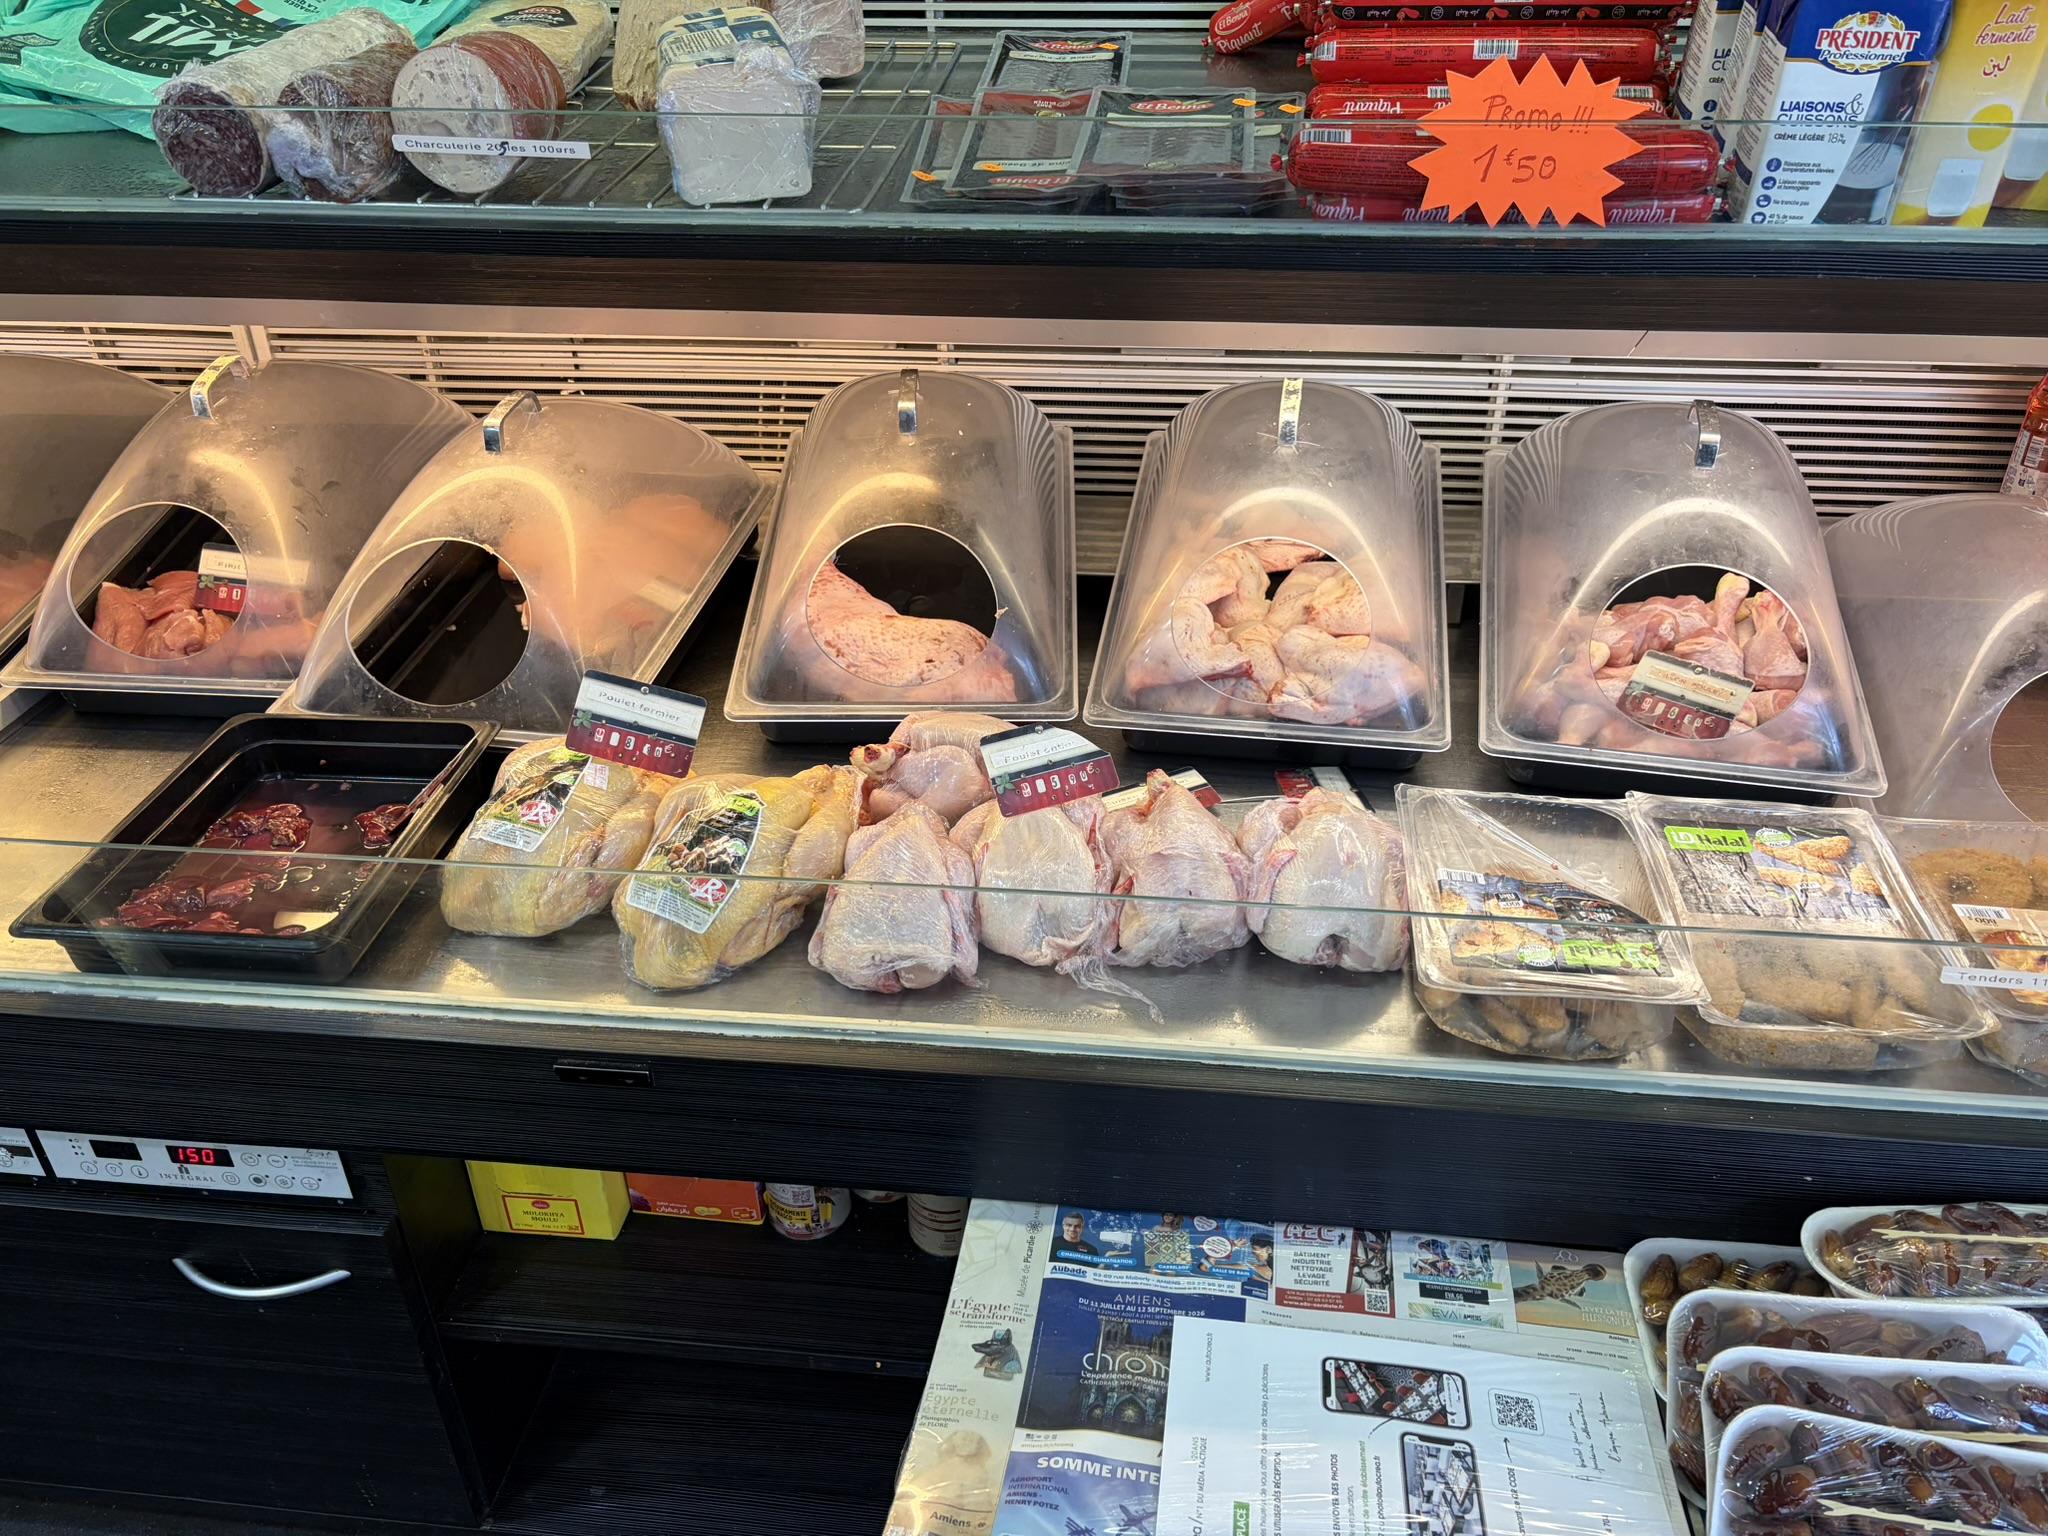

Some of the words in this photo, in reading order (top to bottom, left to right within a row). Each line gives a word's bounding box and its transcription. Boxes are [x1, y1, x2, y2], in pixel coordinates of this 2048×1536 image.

[1995, 2, 2033, 26] Lait
[1215, 21, 1263, 53] Piquant
[1816, 26, 1921, 51] PRÉSIDENT
[1976, 25, 2037, 47] fermenté
[1819, 48, 1906, 63] Professionnel
[1983, 54, 2011, 77] لبن
[1343, 99, 1401, 115] Piquant
[1780, 100, 1845, 113] LIAISONS
[1844, 93, 1864, 116] &
[1567, 105, 1594, 135] !!!
[405, 139, 482, 151] Charcuterie
[1774, 132, 1798, 141] CRÈME
[1799, 133, 1825, 141] LÉGÈRE
[1696, 833, 1747, 848] Halal
[1957, 971, 2024, 985] Tenders
[177, 1147, 215, 1164] 150
[159, 1172, 217, 1183] INTEGRAL
[1023, 1235, 1036, 1263] Picardie
[1023, 1264, 1031, 1276] de
[1051, 1265, 1088, 1276] Aubade
[1290, 1265, 1334, 1273] NETTOYAGE
[1292, 1258, 1332, 1266] INDUSTRIE
[1016, 1276, 1029, 1298] Musée
[1293, 1279, 1331, 1287] SÉCURITÉ
[950, 1296, 1011, 1315] L'Égypte
[1090, 1300, 1099, 1308] 11
[1099, 1301, 1125, 1311] JUILLET
[1147, 1306, 1187, 1316] SEPTEMBRE
[1114, 1293, 1171, 1307] AMIENS
[961, 1310, 1027, 1324] transforme
[1097, 1314, 1124, 1323] SPECTACLE
[1431, 1308, 1458, 1320] EVA
[1081, 1370, 1133, 1380] L'expérience
[1134, 1374, 1169, 1387] monum
[925, 1391, 977, 1407] Égypte
[922, 1403, 1001, 1422] éternelle
[1198, 1437, 1208, 1468] TACTIQUE
[1036, 1456, 1113, 1478] SOMME
[1116, 1467, 1161, 1485] INTE
[1330, 1454, 1339, 1479] PHOTOS
[1359, 1440, 1368, 1488] établissement
[1197, 1470, 1206, 1492] MÉDIA
[1507, 1467, 1517, 1488] CODE
[1007, 1483, 1070, 1496] INTERNATIONAL
[1331, 1480, 1340, 1496] DES
[1374, 1455, 1386, 1520] photo@autocrea.fr
[1004, 1499, 1032, 1507] HENRY
[1032, 1501, 1060, 1511] POTEZ
[1197, 1493, 1205, 1504] DU
[1361, 1489, 1369, 1508] votre
[929, 1511, 971, 1528] Amiens
[1273, 1504, 1282, 1531] UTILISER
[1331, 1498, 1341, 1531] ENVOYER
[1362, 1510, 1370, 1519] de
